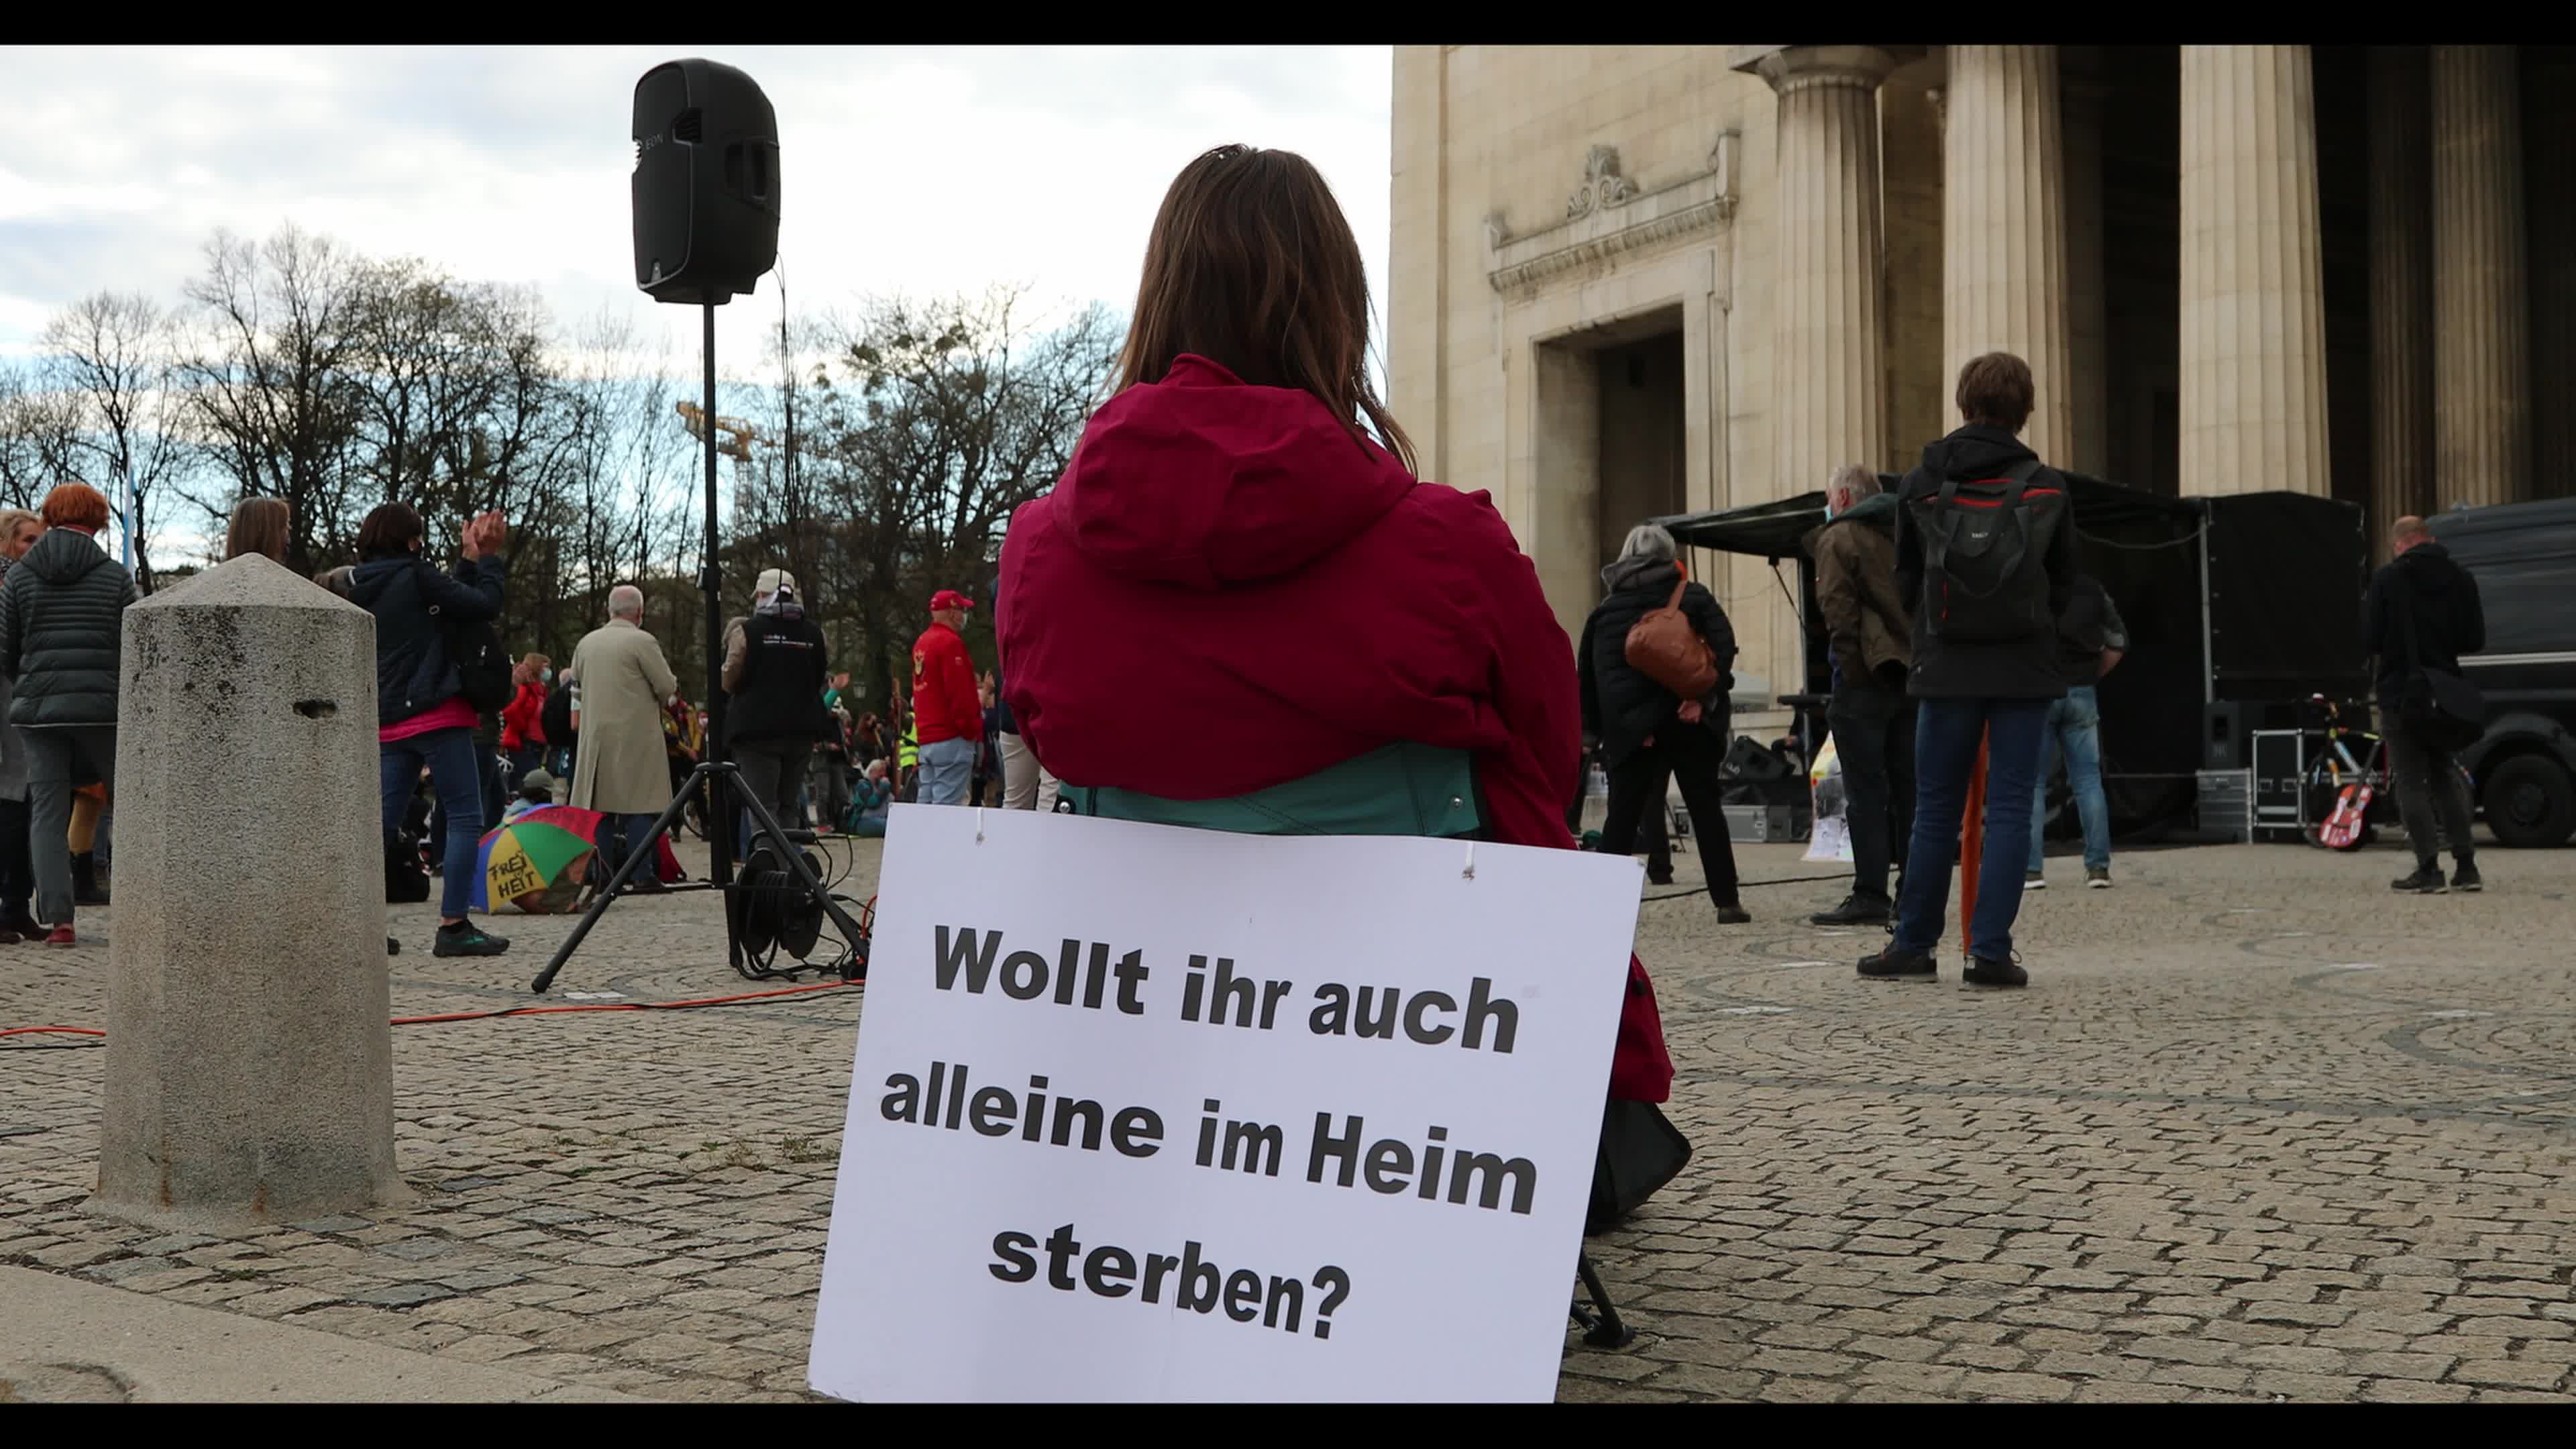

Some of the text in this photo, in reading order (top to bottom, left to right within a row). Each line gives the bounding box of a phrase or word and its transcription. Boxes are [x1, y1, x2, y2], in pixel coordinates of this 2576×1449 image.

[498, 870, 535, 898] HEIT
[934, 925, 1519, 1054] Wollt ihr auch
[881, 1061, 1537, 1215] alleine im Heim
[988, 1224, 1350, 1340] sterben?
